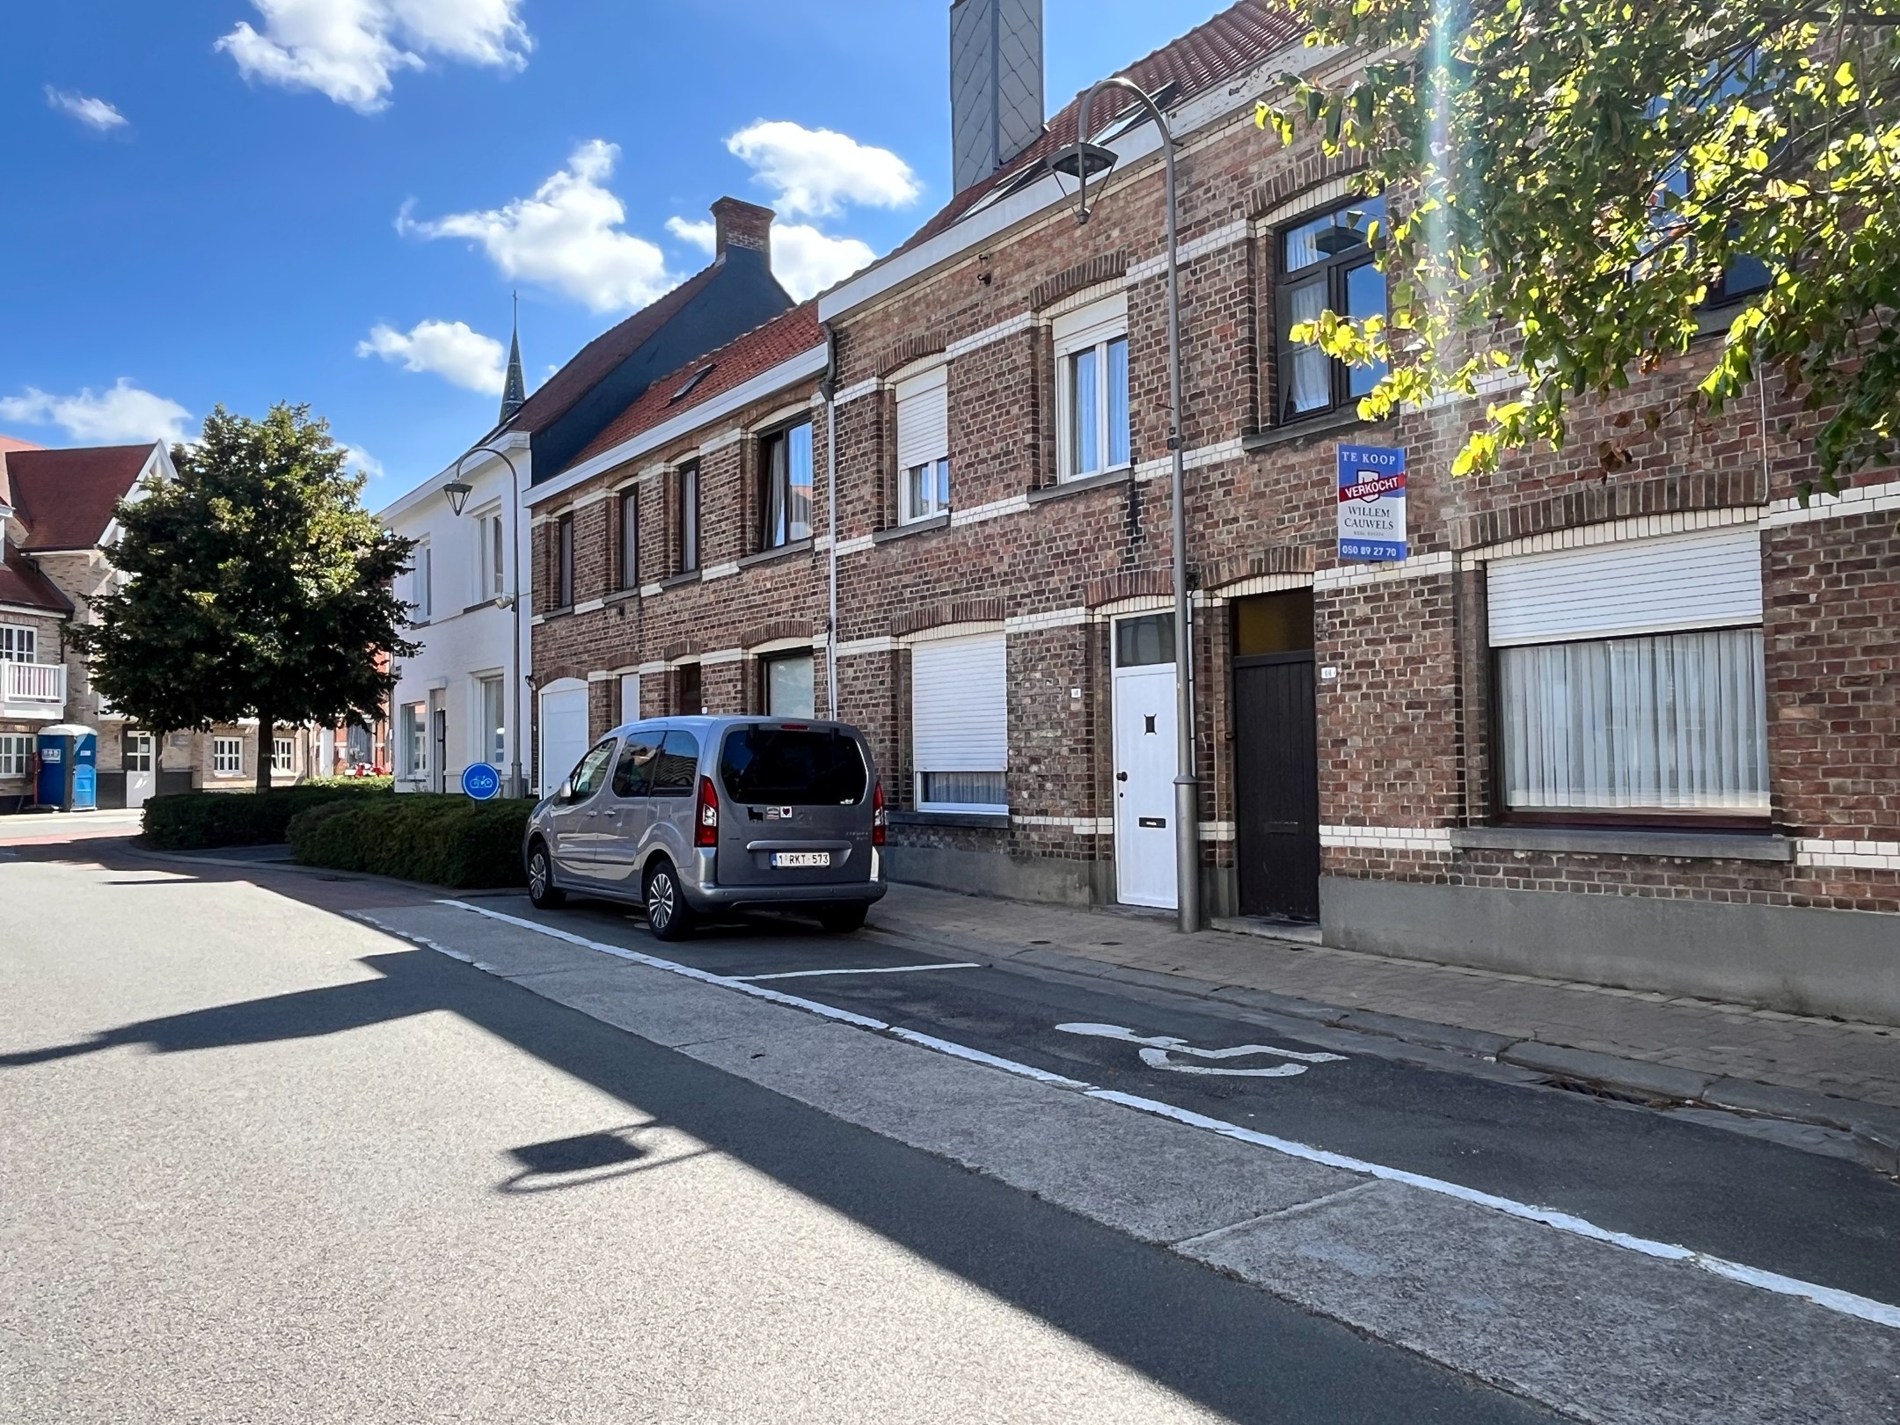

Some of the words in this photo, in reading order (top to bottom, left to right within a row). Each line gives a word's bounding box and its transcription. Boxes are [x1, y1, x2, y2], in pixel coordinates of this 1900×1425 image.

[1341, 452, 1358, 462] TE
[1362, 453, 1396, 465] KOOP
[1345, 477, 1399, 498] VERKOCHT
[1348, 506, 1390, 518] WILLEM
[1344, 518, 1394, 530] CAUWELS
[1342, 545, 1358, 554] 050
[1373, 547, 1383, 556] 27
[1386, 548, 1397, 557] 70
